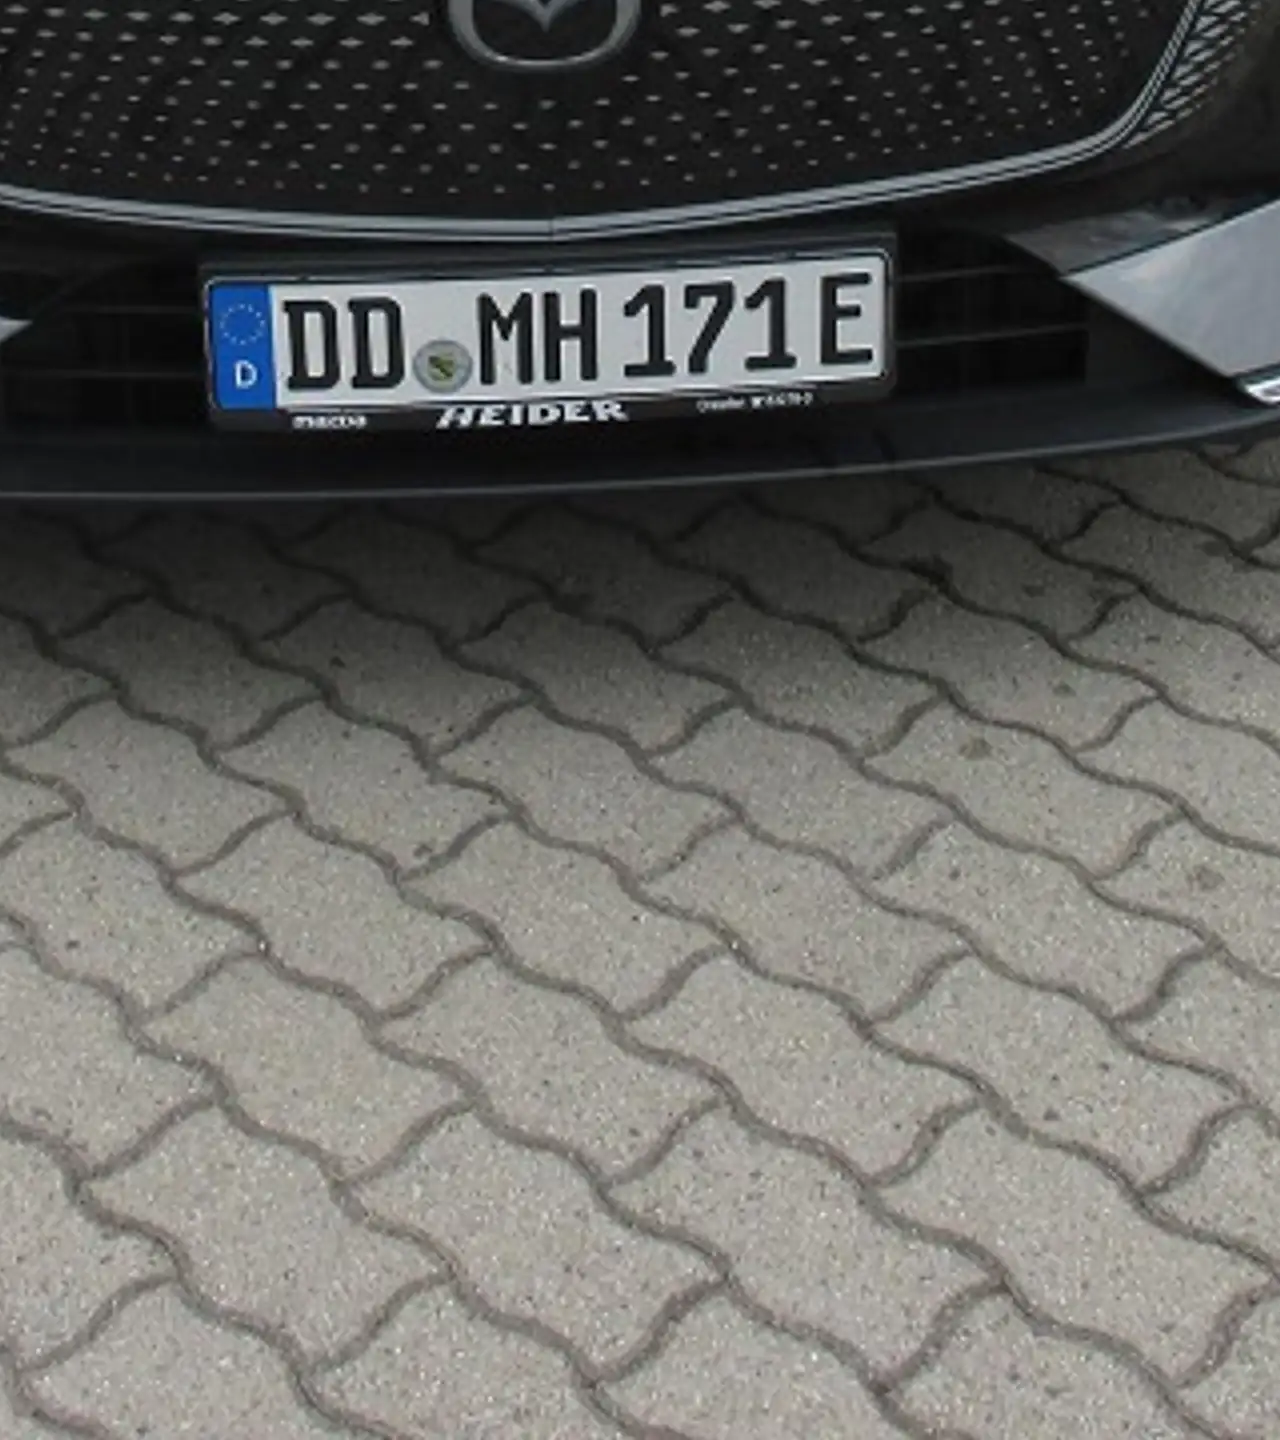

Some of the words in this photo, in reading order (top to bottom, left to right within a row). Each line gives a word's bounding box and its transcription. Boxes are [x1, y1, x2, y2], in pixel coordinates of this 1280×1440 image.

[283, 296, 405, 389] DD
[235, 360, 258, 390] D
[435, 398, 629, 430] HEIDER
